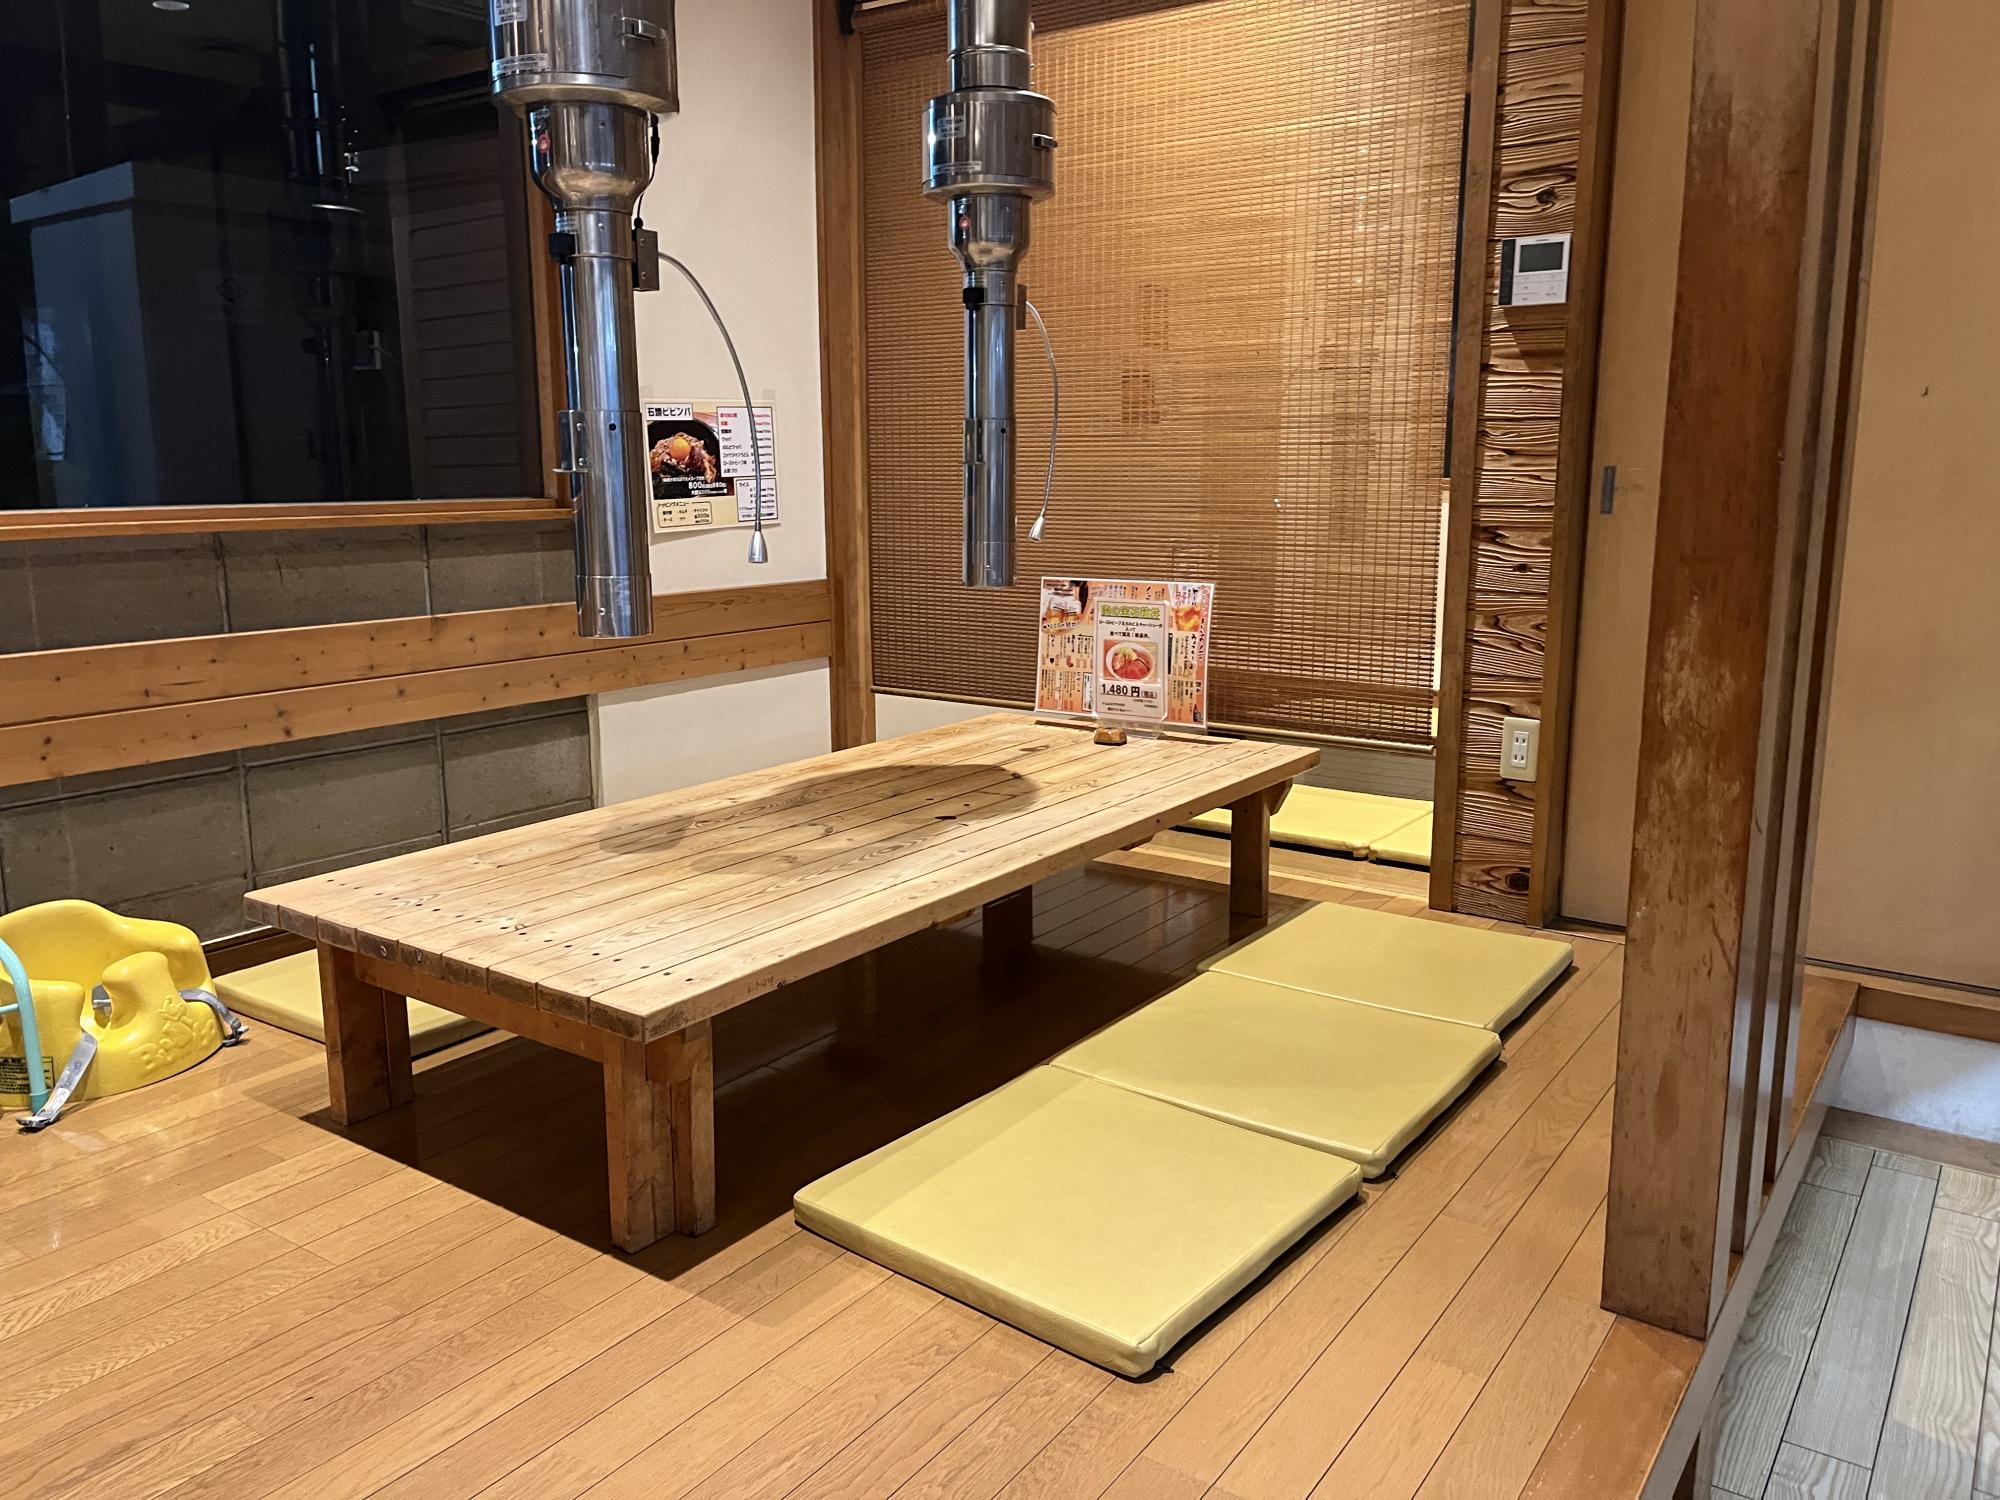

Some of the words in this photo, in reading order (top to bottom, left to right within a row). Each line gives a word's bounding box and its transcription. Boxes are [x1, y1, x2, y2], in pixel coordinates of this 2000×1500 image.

[647, 407, 691, 417] 石焼ビビンバ
[1101, 683, 1128, 695] 1,480
